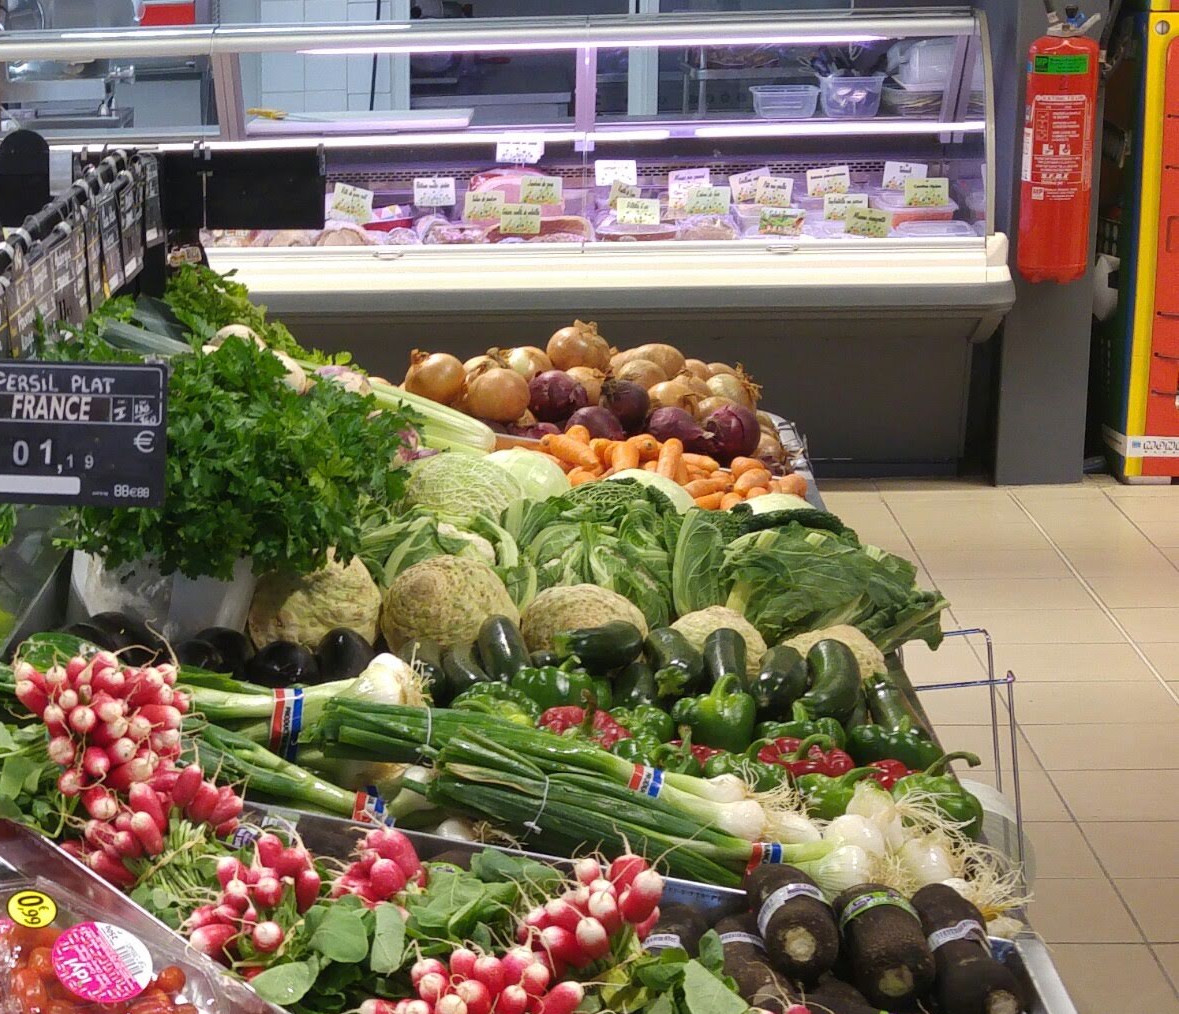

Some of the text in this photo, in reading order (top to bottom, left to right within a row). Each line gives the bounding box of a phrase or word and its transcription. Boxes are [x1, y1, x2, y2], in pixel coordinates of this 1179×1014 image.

[71, 375, 115, 394] PLAT
[11, 394, 92, 421] FRANCE
[133, 430, 155, 453] €
[64, 958, 93, 986] idyl
